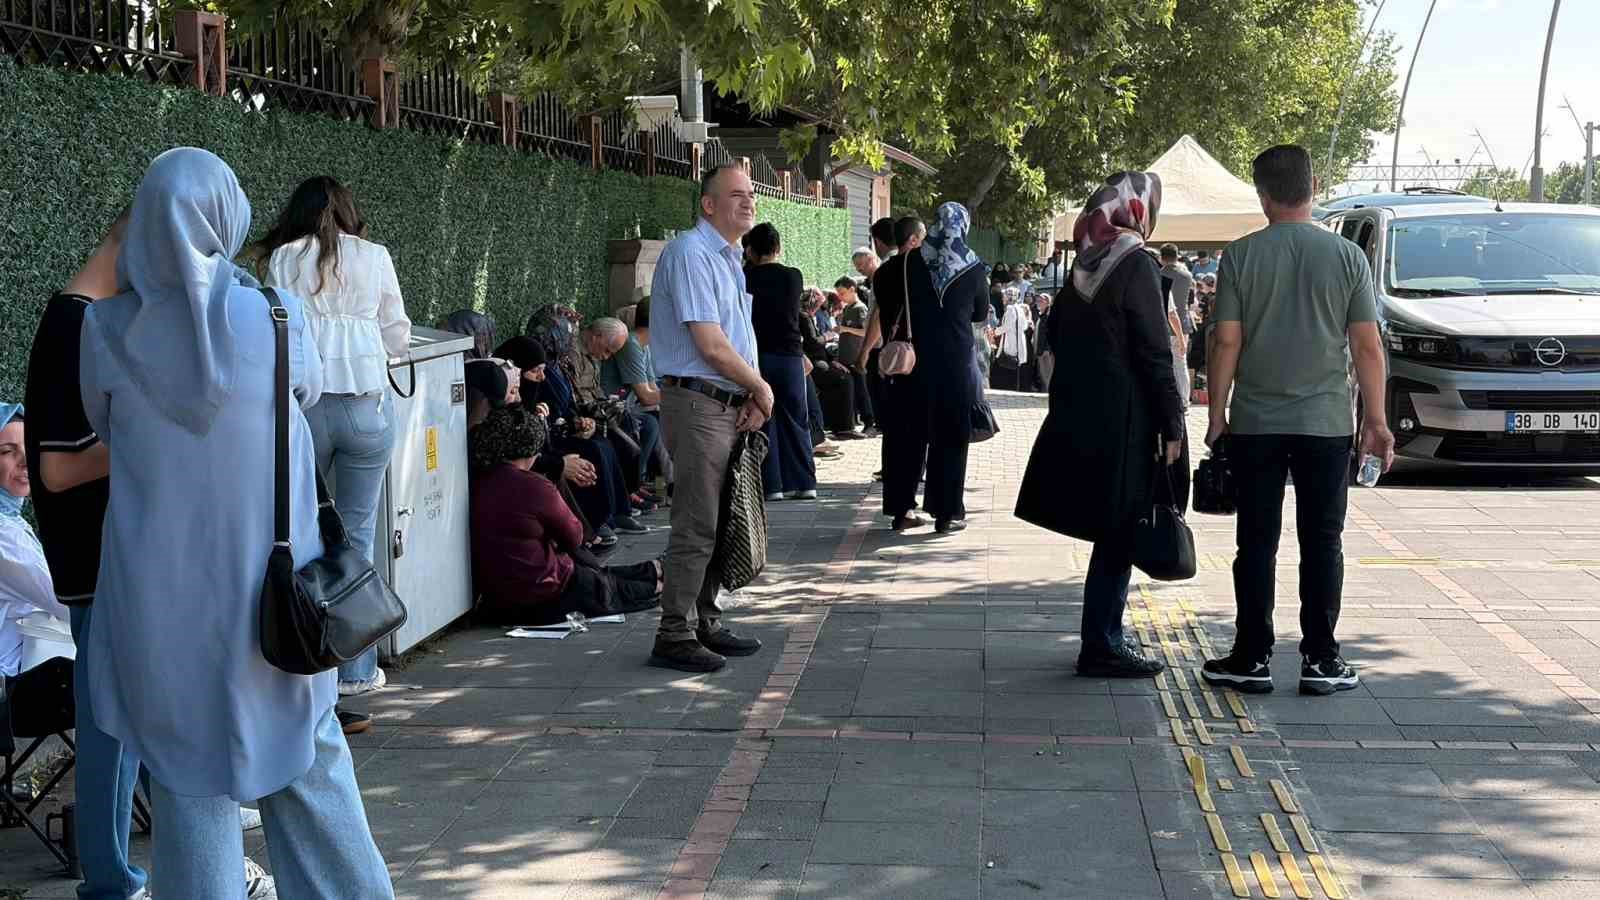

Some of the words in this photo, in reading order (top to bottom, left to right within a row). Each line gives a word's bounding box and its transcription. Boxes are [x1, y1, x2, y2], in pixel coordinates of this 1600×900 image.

[1515, 414, 1532, 429] 38
[1544, 414, 1561, 429] DB
[1573, 414, 1598, 429] 140
